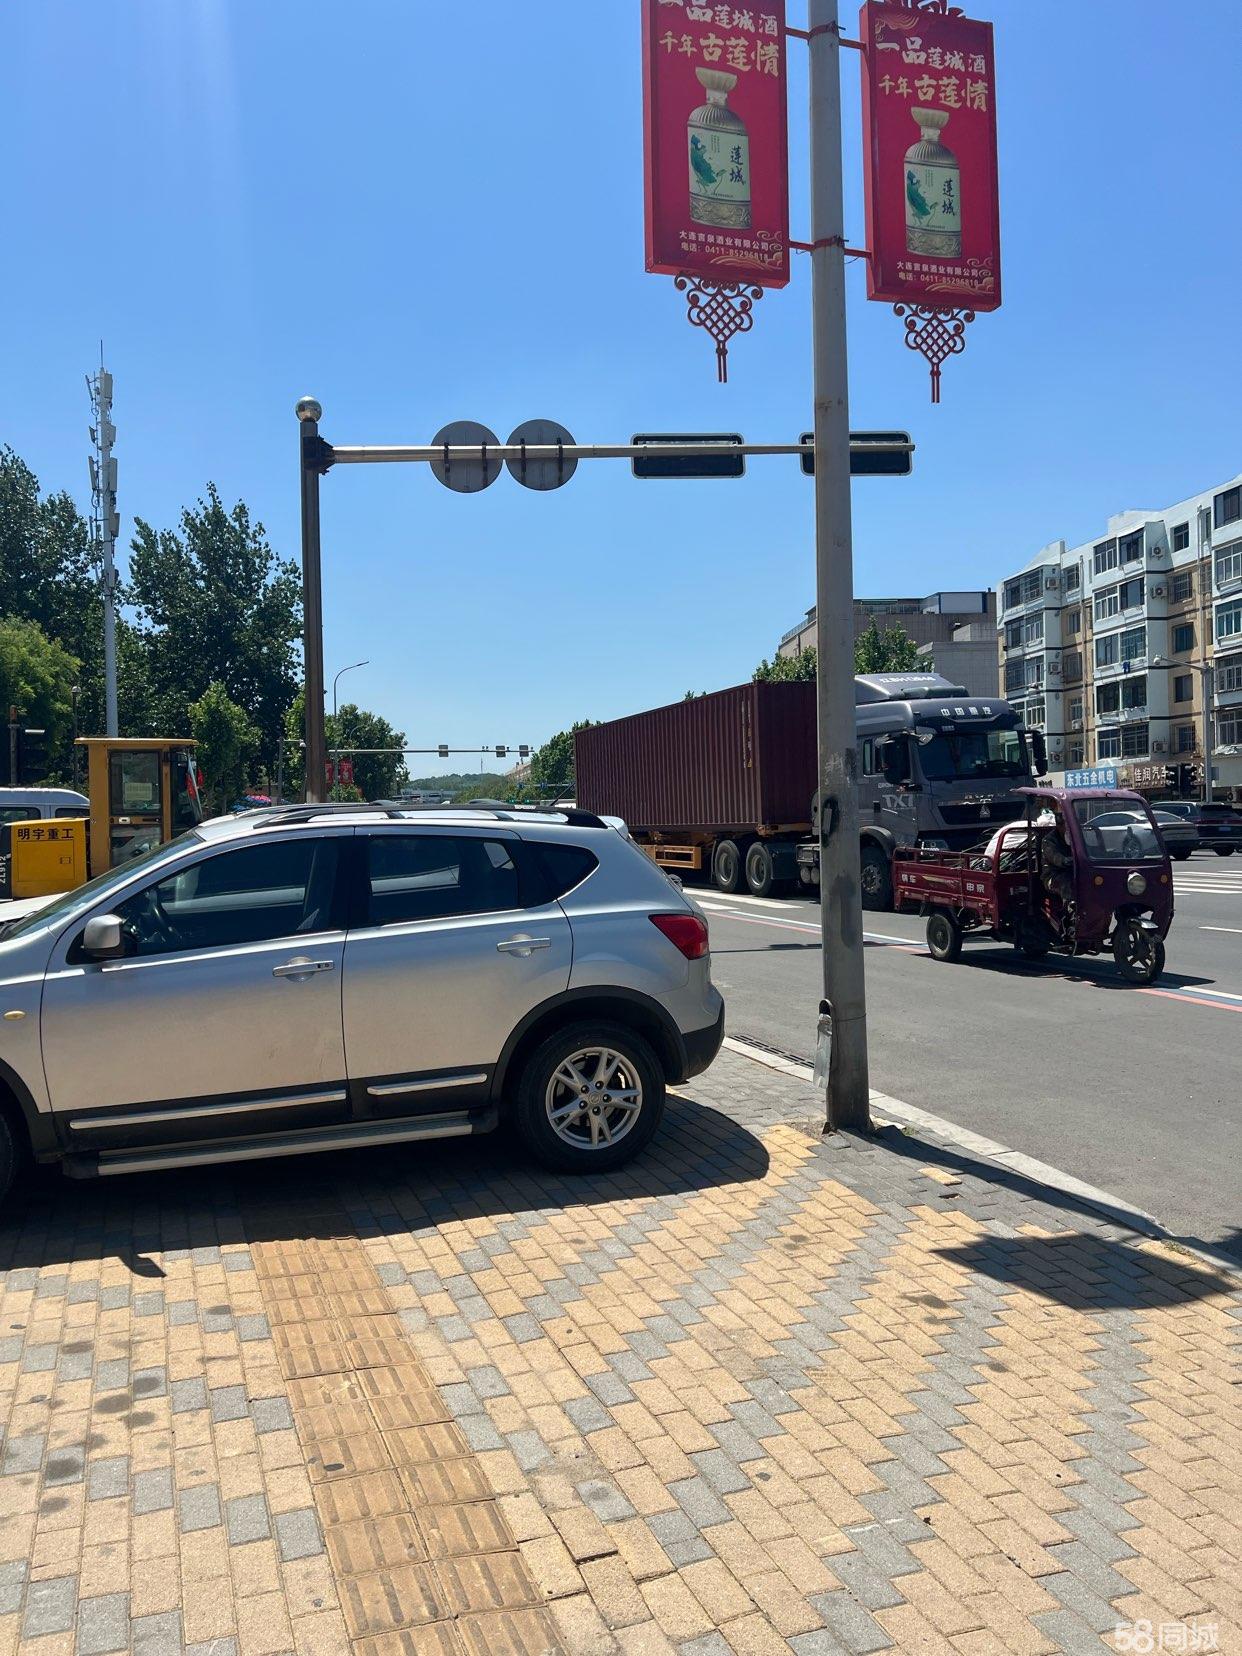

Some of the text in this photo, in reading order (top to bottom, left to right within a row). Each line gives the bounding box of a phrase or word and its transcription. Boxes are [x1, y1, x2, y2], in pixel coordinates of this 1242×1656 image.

[659, 30, 779, 77] 千年古莲情
[876, 37, 985, 74] 一品莲城酒
[878, 74, 988, 112] 千年古莲情
[1066, 769, 1115, 787] 东北五金机电
[17, 828, 74, 840] 明宇重工
